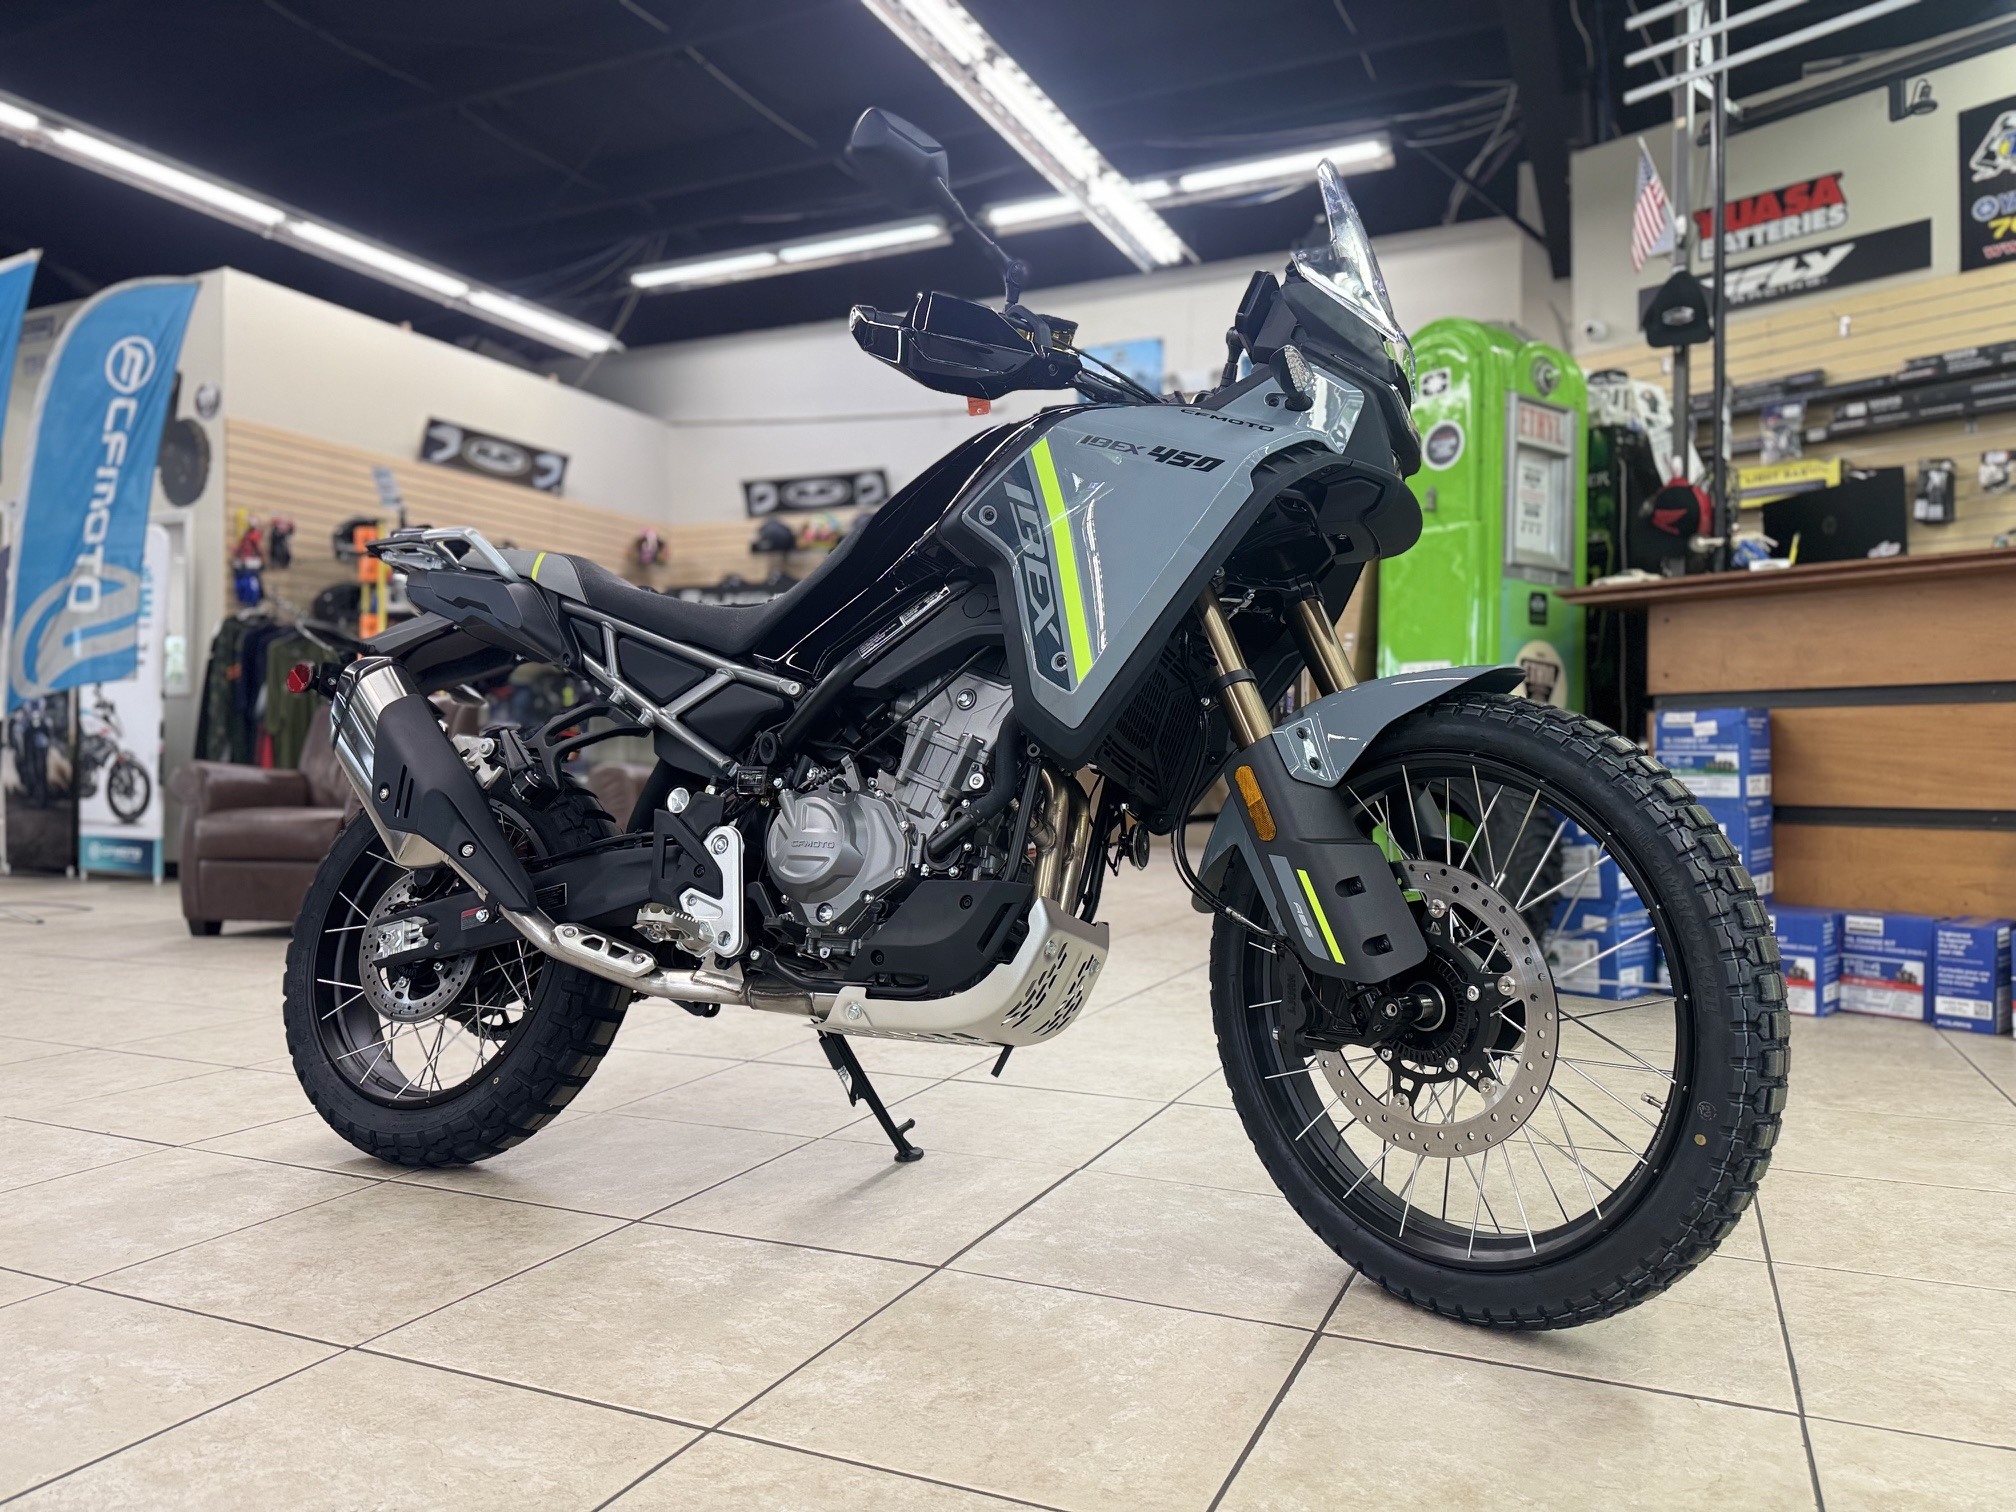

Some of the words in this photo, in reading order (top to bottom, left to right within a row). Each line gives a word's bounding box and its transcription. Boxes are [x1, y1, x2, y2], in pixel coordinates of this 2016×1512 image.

[1693, 171, 1846, 240] YUASA
[1700, 202, 1849, 262] BATTERIES
[1180, 407, 1275, 432] CFMOTO
[1075, 434, 1147, 456] IBEX
[1147, 445, 1227, 473] 450
[67, 397, 138, 613] CFMOTO
[1003, 480, 1061, 646] IBEX
[791, 839, 836, 849] CFMOTO
[1293, 902, 1314, 938] ABS
